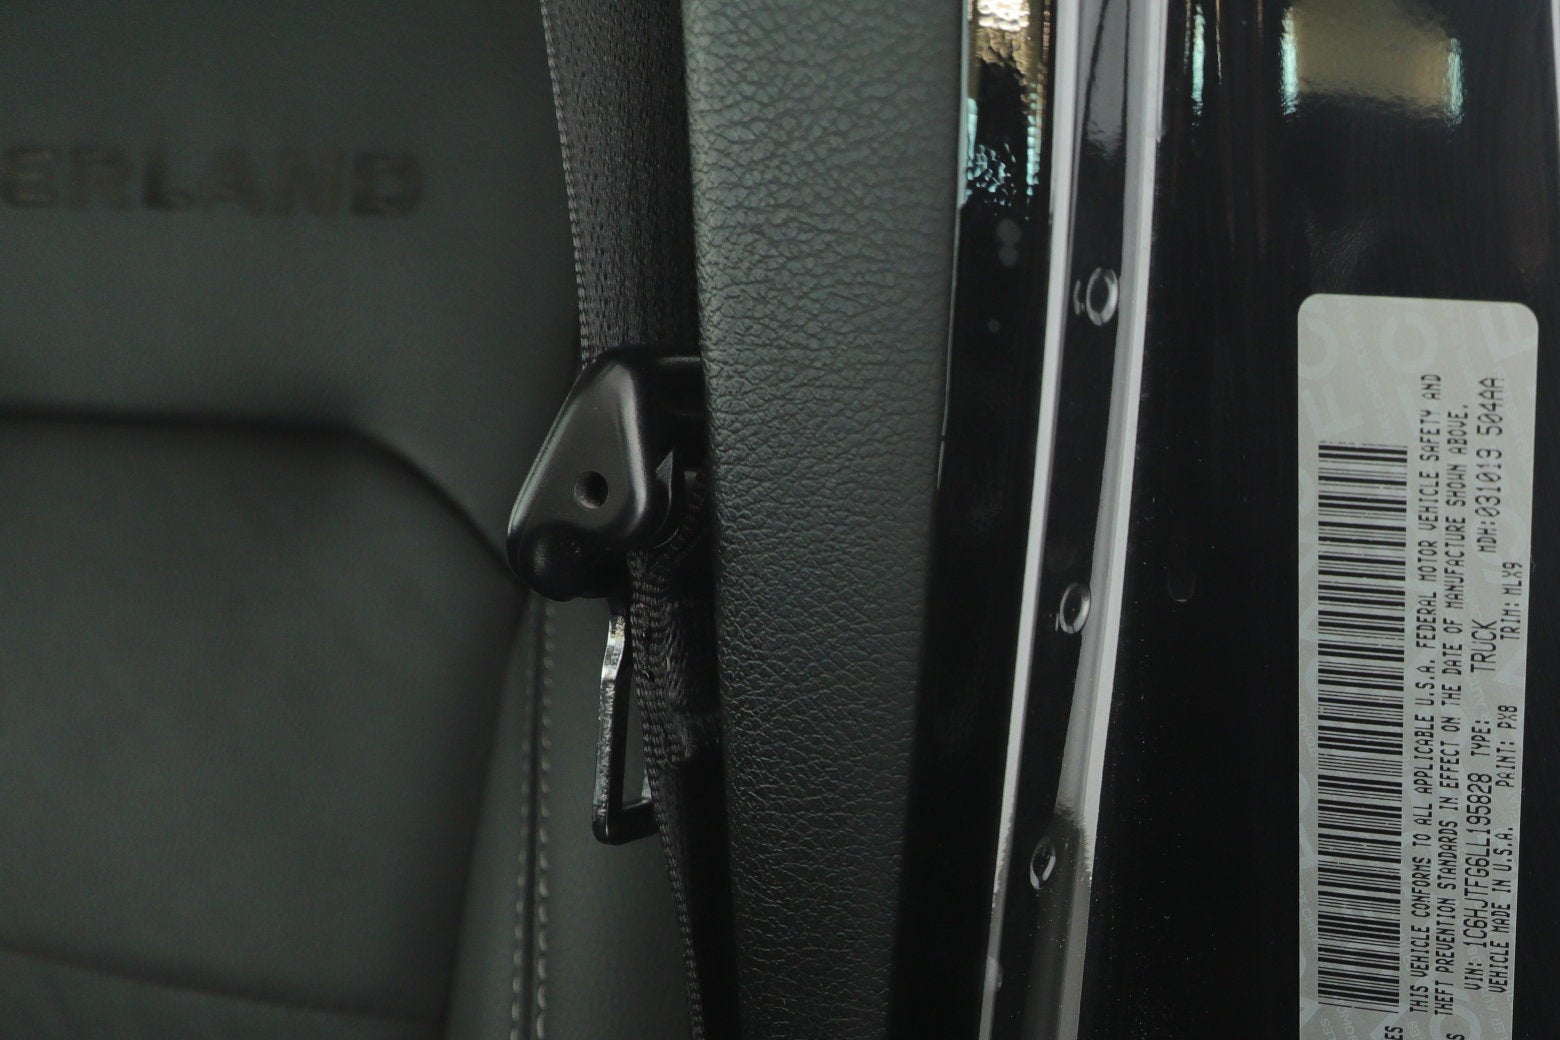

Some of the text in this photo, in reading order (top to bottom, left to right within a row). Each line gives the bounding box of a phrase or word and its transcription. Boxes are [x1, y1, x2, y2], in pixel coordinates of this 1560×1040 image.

[1477, 378, 1504, 436] 504AA
[1410, 375, 1441, 1013] THIS VEHICLE CONFORMS TO ALL APPLICABLE U.S.A. FEDERAL MOTOR VEHICLE SAFETY AND
[1470, 619, 1496, 672] TRUCK
[1435, 404, 1468, 1015] THEFT PREVENTION STANDARDS IN EFFECT ON THE DATE OF MANUFACTURE SHOWN ABOVE.
[1471, 720, 1491, 757] TYPE:
[1489, 562, 1522, 993] VEHICLE MADE IN U.S.A. PAINT: PX8 TRIM: MLX9
[1464, 773, 1492, 948] 1C6HJTFG6LL195828
[1465, 962, 1482, 990] VIN:
